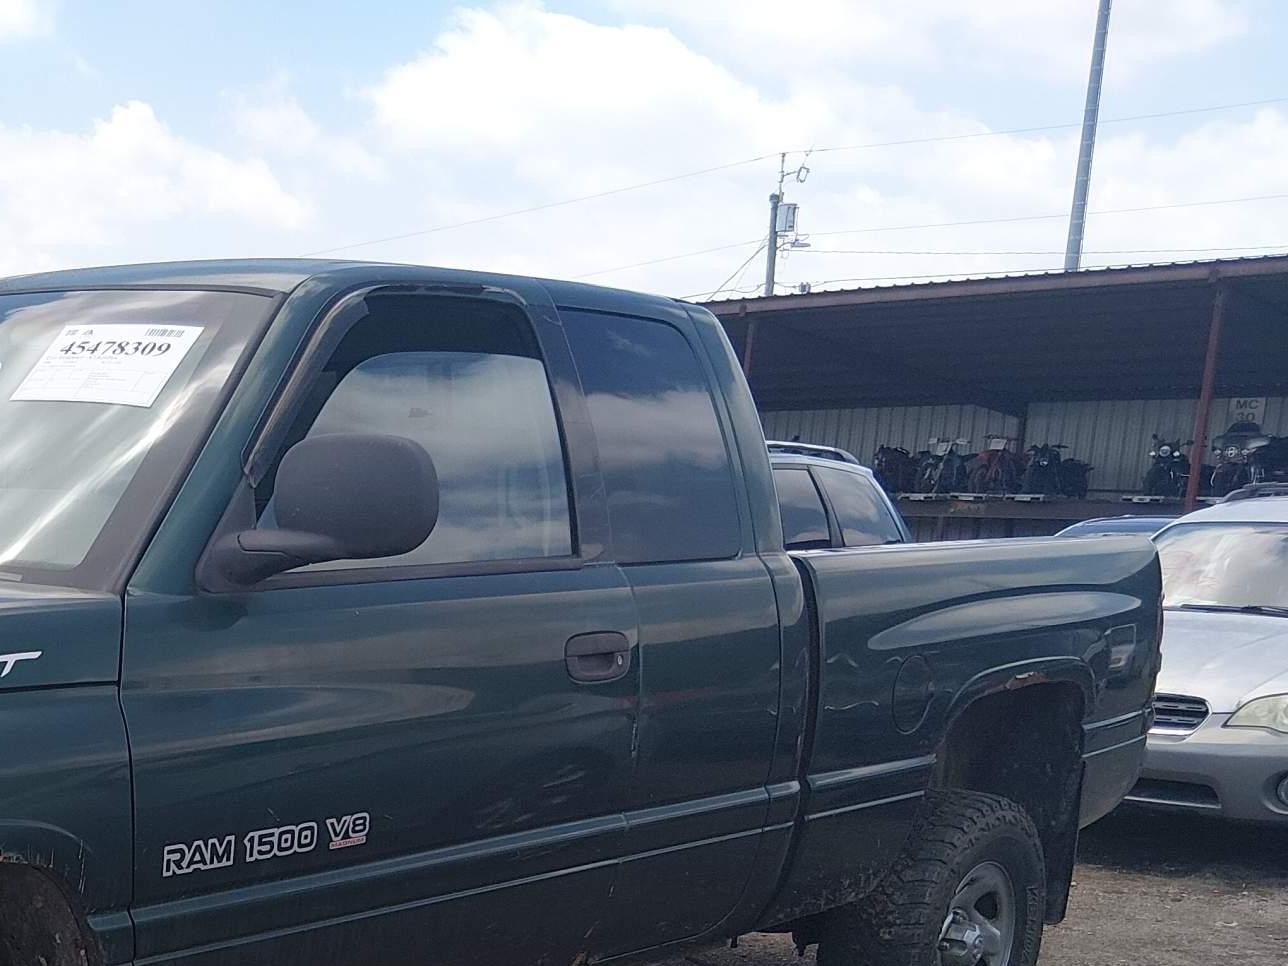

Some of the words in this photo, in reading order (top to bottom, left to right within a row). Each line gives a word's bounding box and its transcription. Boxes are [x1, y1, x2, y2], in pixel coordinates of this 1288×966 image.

[59, 340, 172, 357] 45478309
[1236, 399, 1259, 410] MC
[162, 834, 236, 877] RAM
[243, 821, 318, 862] 1500
[325, 811, 370, 842] V8
